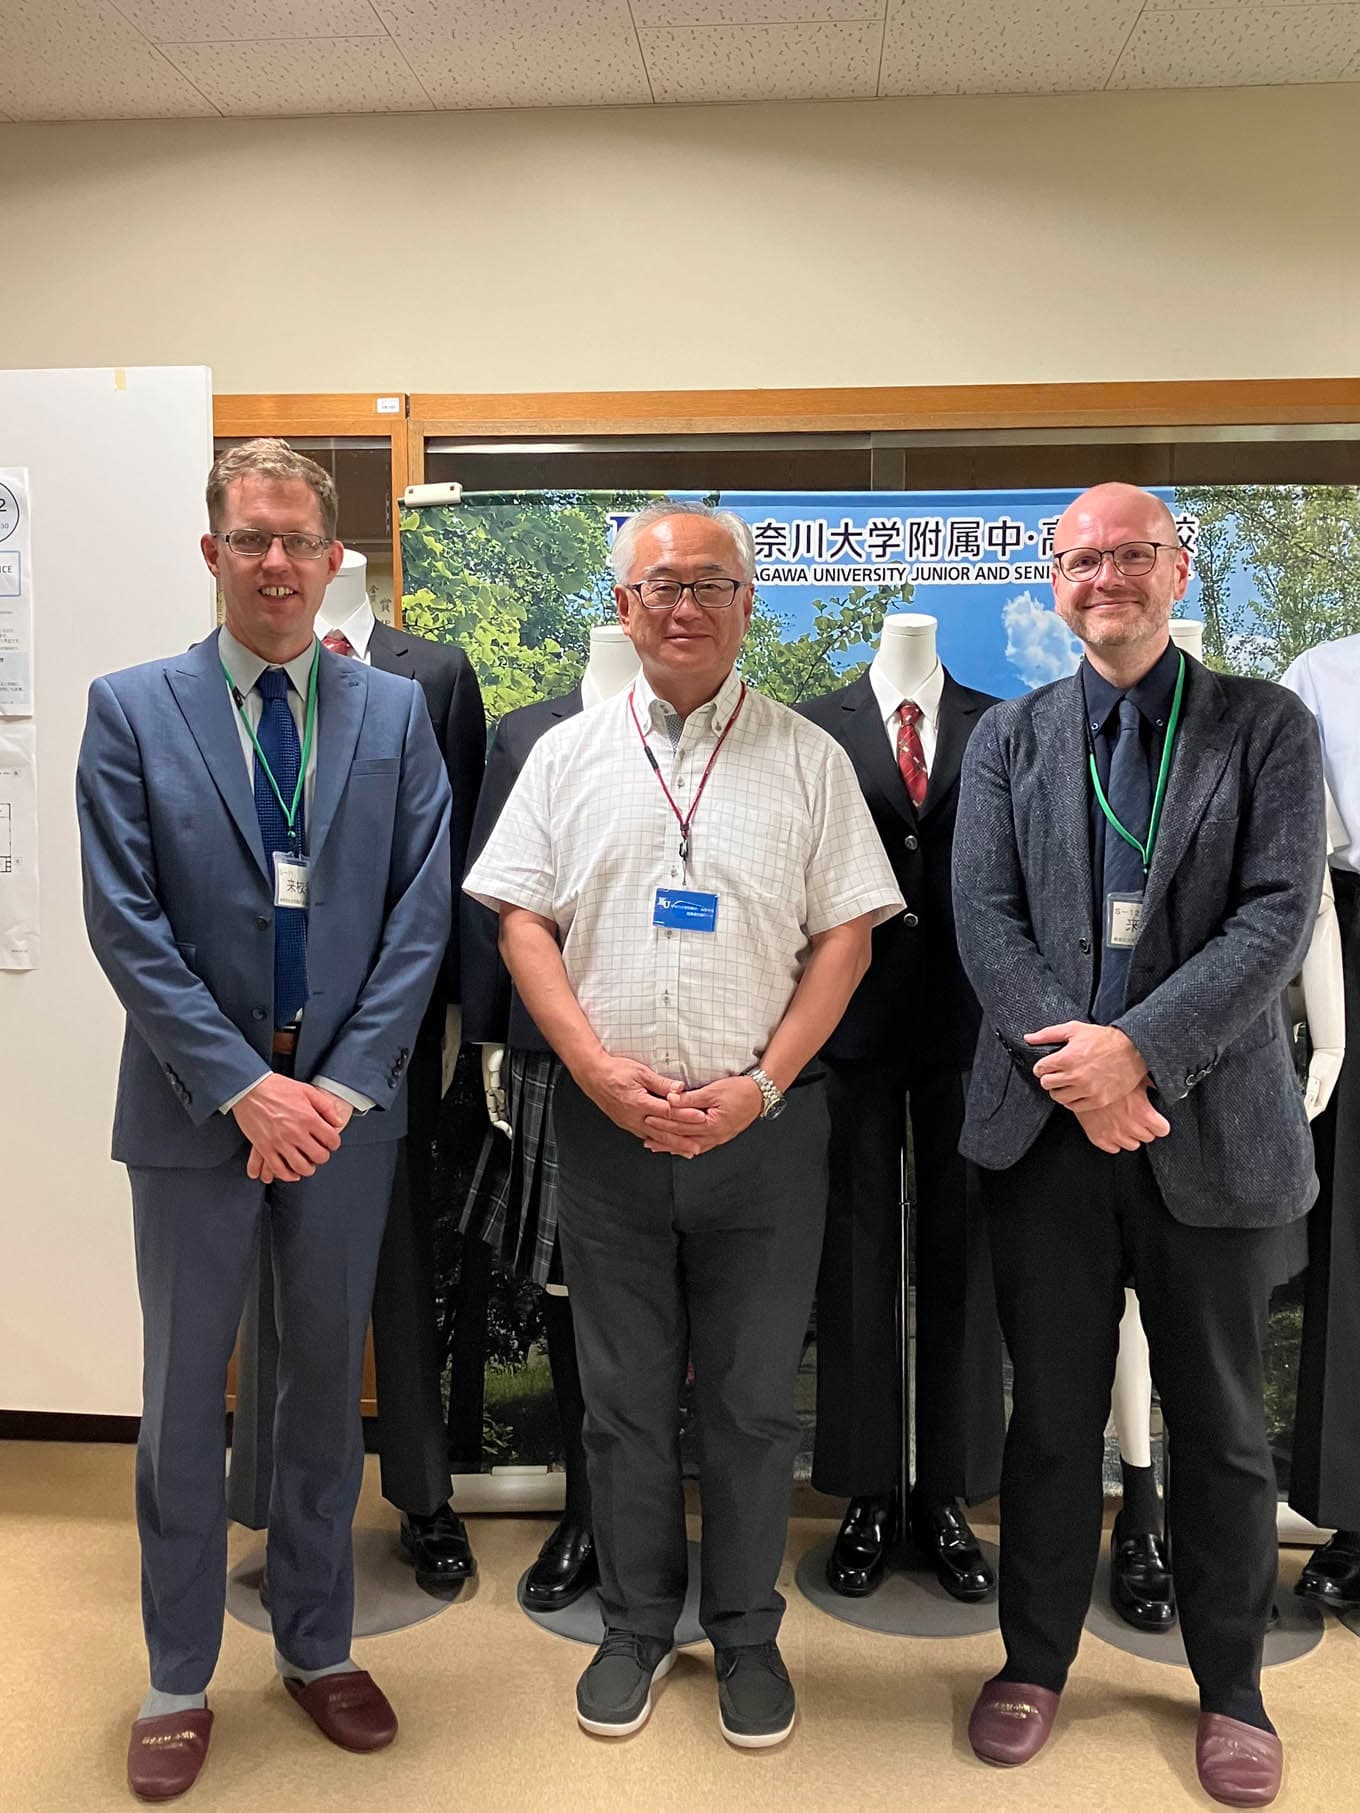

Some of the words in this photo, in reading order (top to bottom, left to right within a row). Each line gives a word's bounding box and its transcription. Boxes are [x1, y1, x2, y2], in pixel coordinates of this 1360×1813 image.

[813, 567, 906, 582] UNIVERSITY
[911, 566, 970, 581] JUNIOR
[975, 566, 1010, 581] AND
